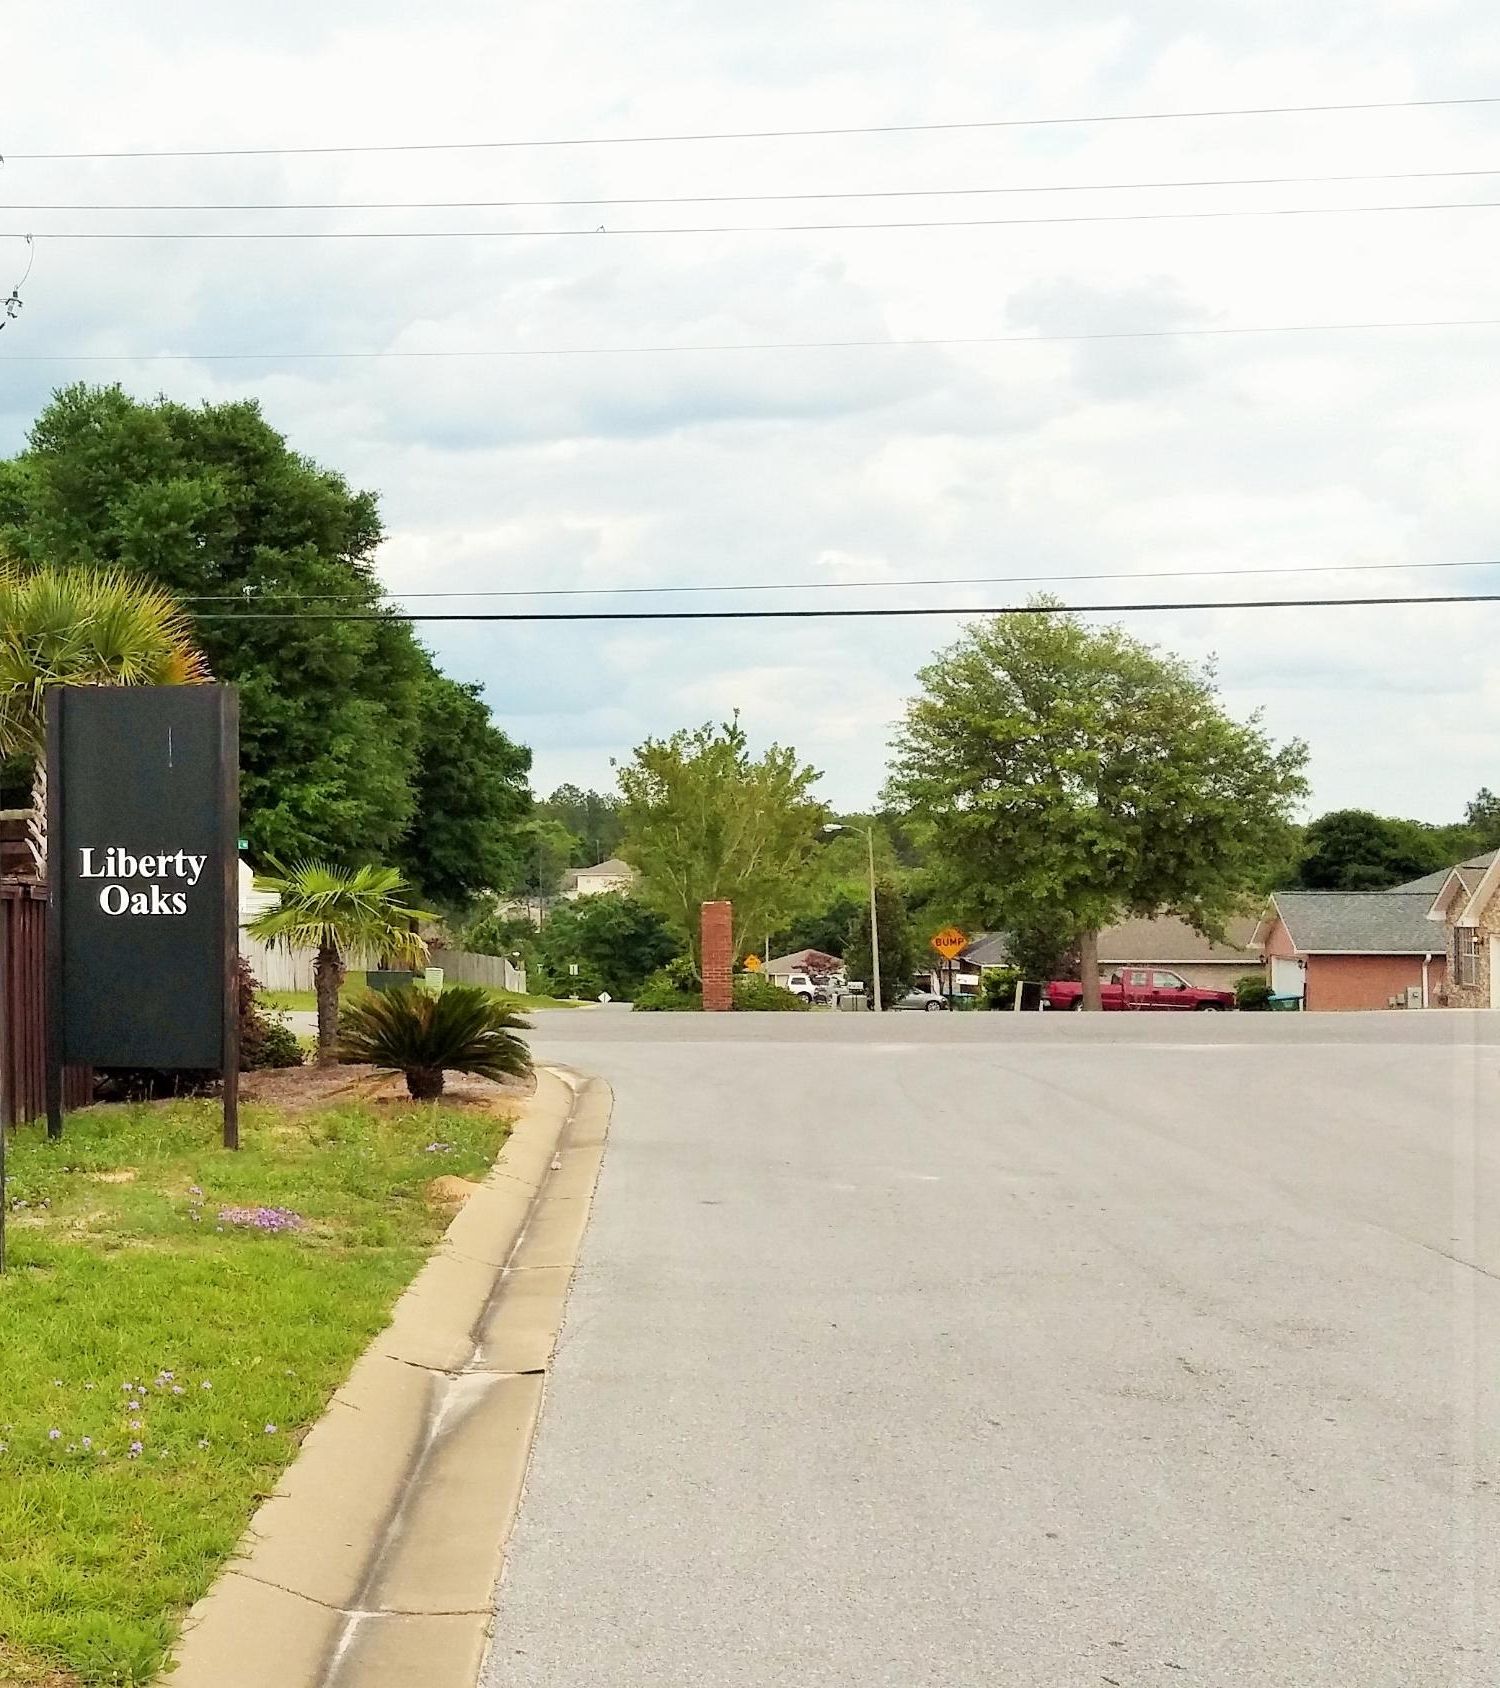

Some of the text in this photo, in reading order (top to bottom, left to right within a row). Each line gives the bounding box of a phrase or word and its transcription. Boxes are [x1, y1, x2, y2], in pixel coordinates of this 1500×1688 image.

[79, 848, 208, 886] Liberty
[100, 885, 187, 915] Oaks
[935, 937, 964, 947] BUMP
